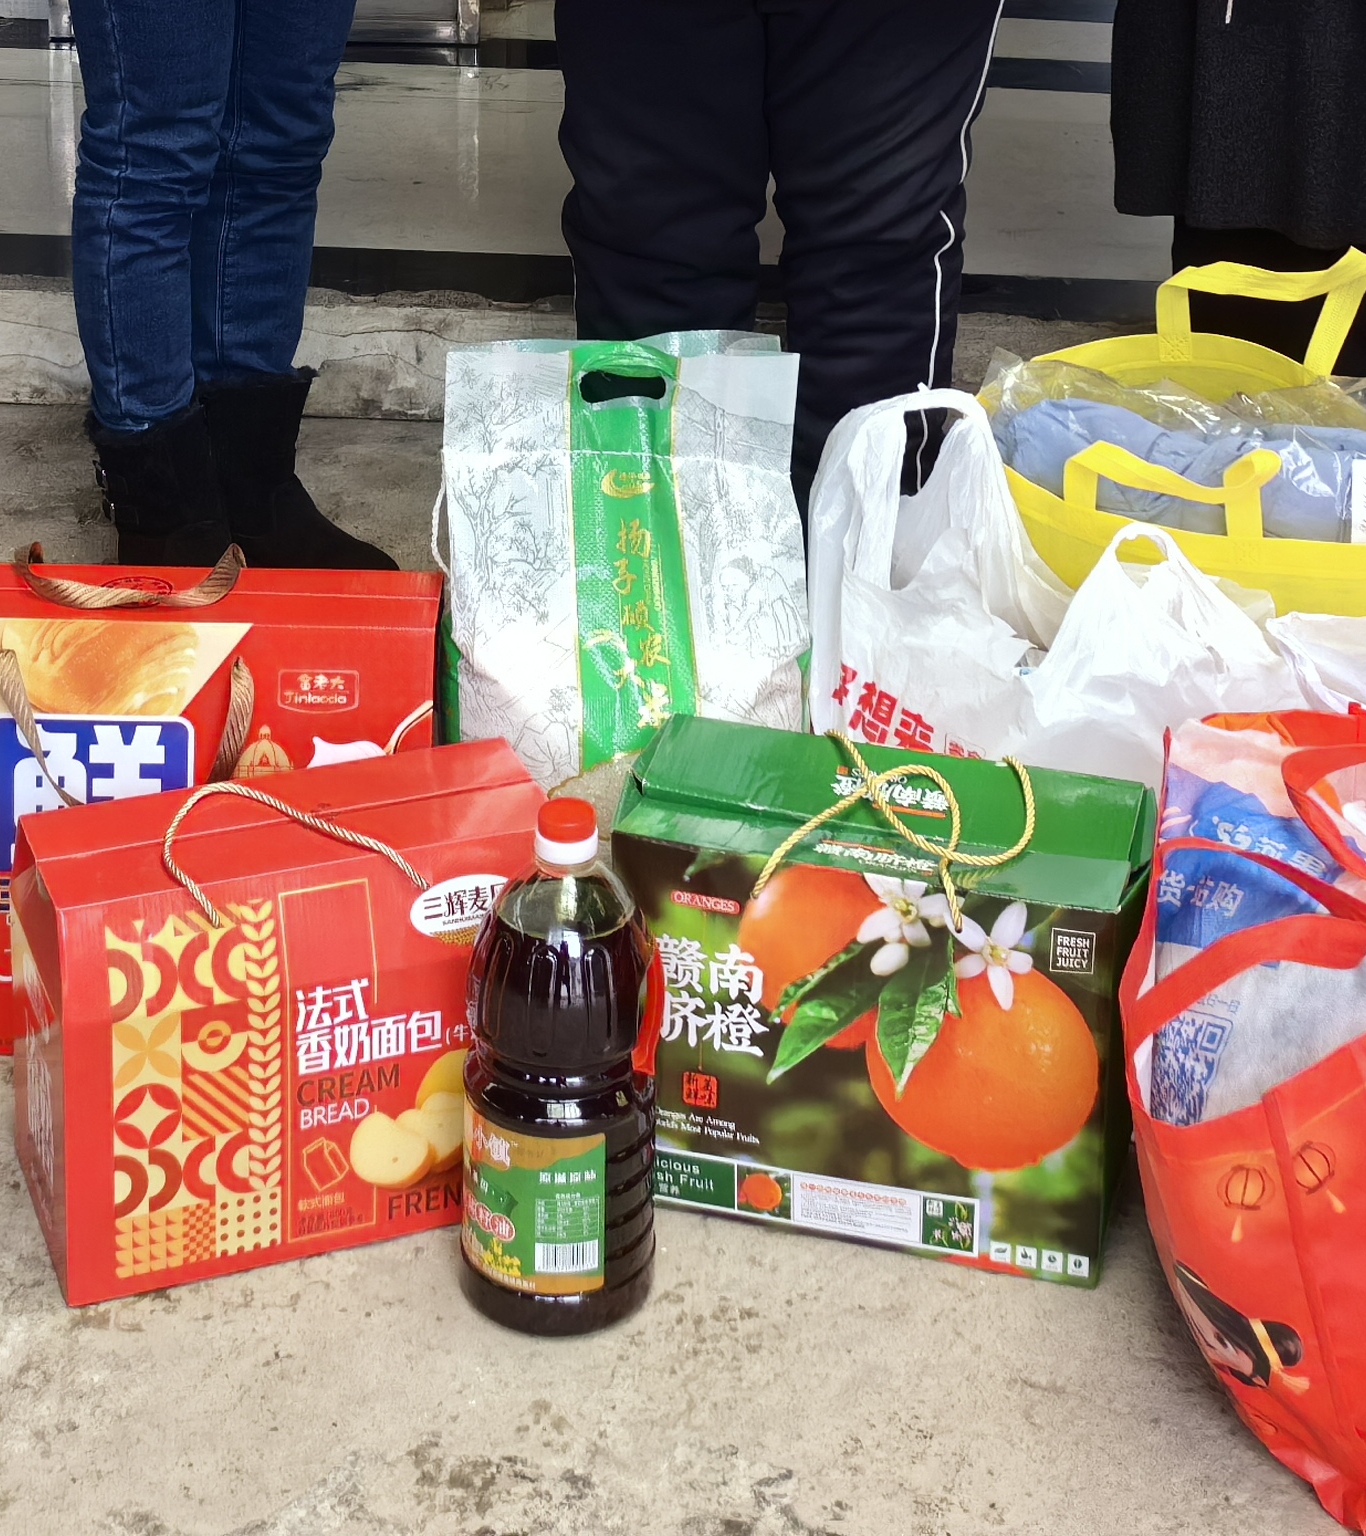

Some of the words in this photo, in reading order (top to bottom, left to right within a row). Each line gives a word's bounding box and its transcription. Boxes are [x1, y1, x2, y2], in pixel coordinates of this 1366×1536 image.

[673, 890, 736, 913] ORANGES
[1056, 946, 1089, 958] FRUIT
[1057, 935, 1090, 949] FRESH
[1056, 957, 1089, 968] JUICY
[295, 978, 370, 1033] 法式
[296, 1010, 443, 1076] 香奶面包
[296, 1063, 400, 1107] CREAM
[300, 1098, 370, 1131] BREAD
[706, 1116, 736, 1131] Among
[704, 1126, 735, 1141] Popular
[736, 1132, 761, 1146] Fruits
[679, 1174, 715, 1192] Fruit
